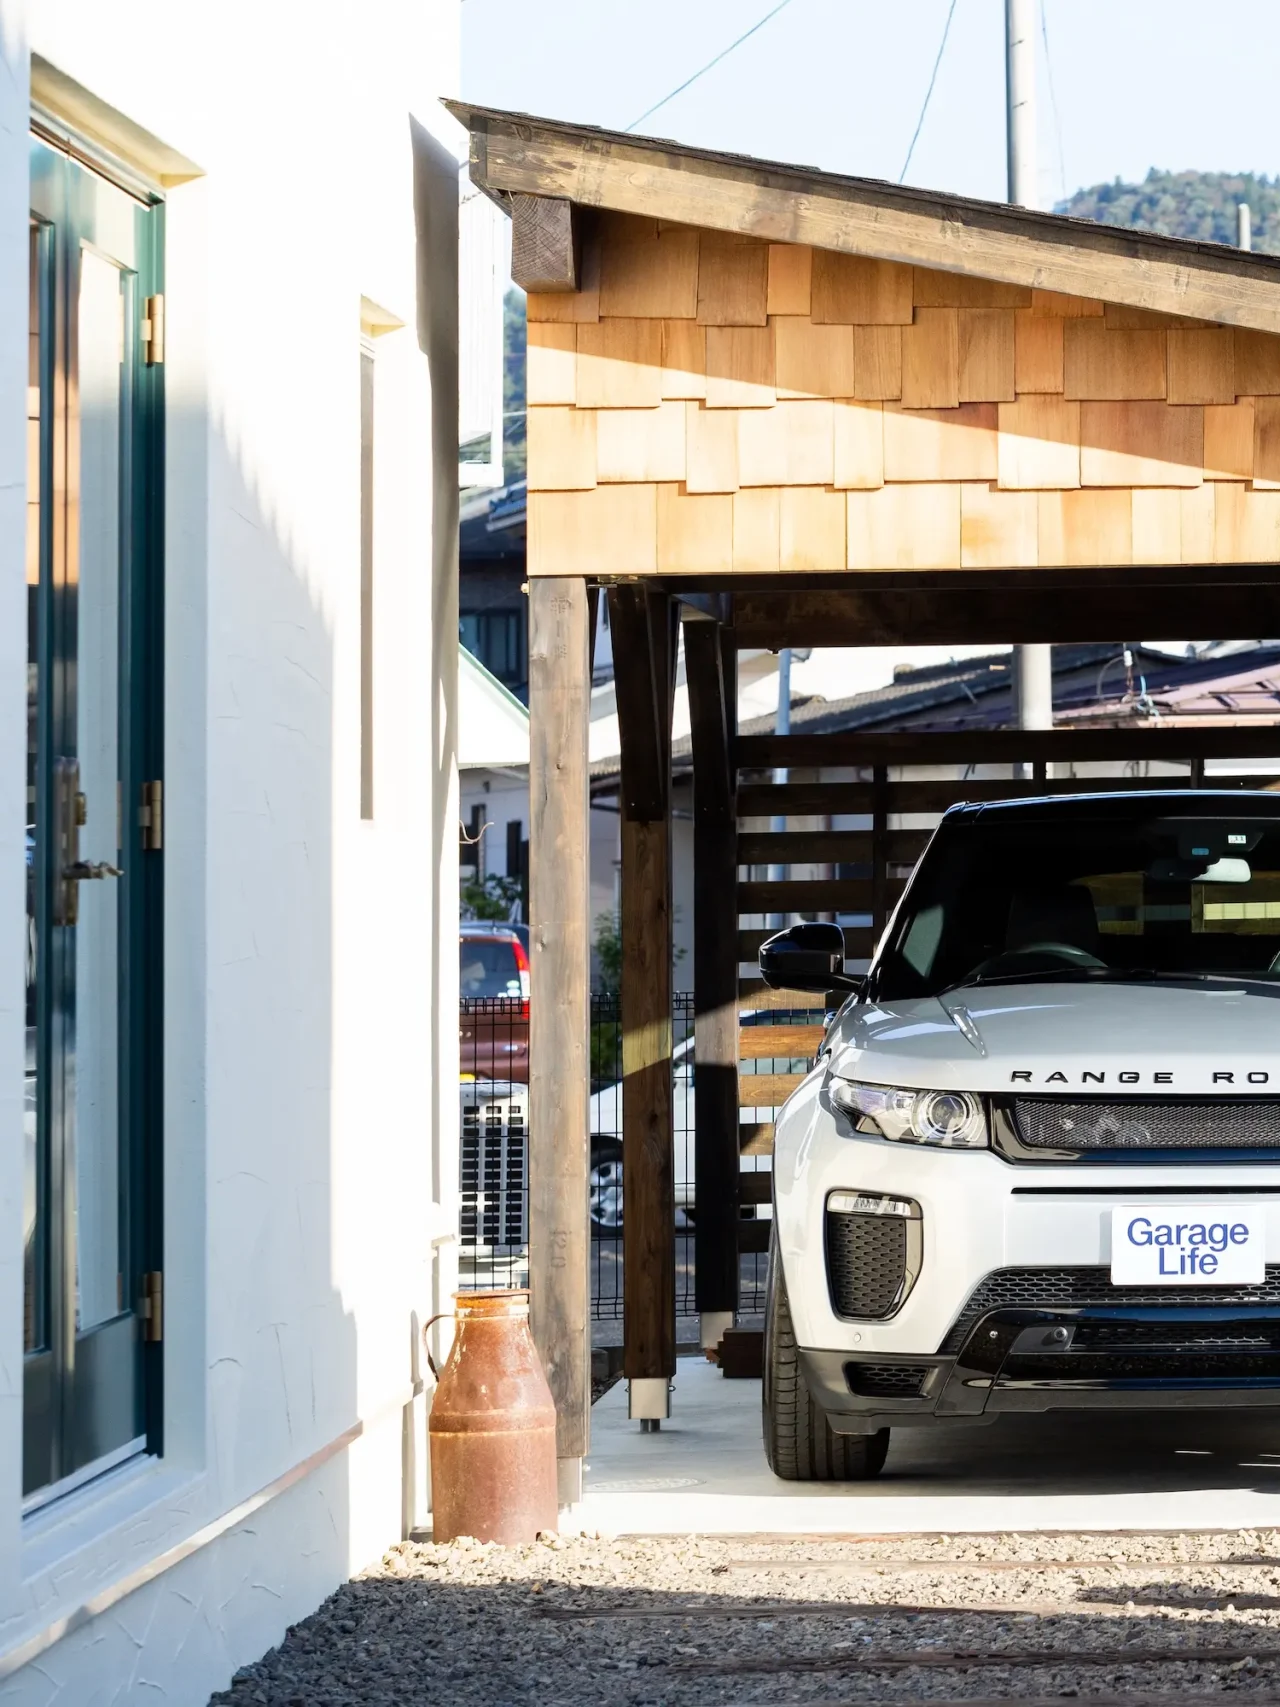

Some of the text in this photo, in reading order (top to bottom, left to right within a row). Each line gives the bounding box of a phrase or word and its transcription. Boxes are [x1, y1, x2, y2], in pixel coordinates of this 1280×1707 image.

[1010, 1070, 1174, 1084] RANGE
[1127, 1217, 1250, 1252] Garage
[1158, 1247, 1219, 1276] Life
